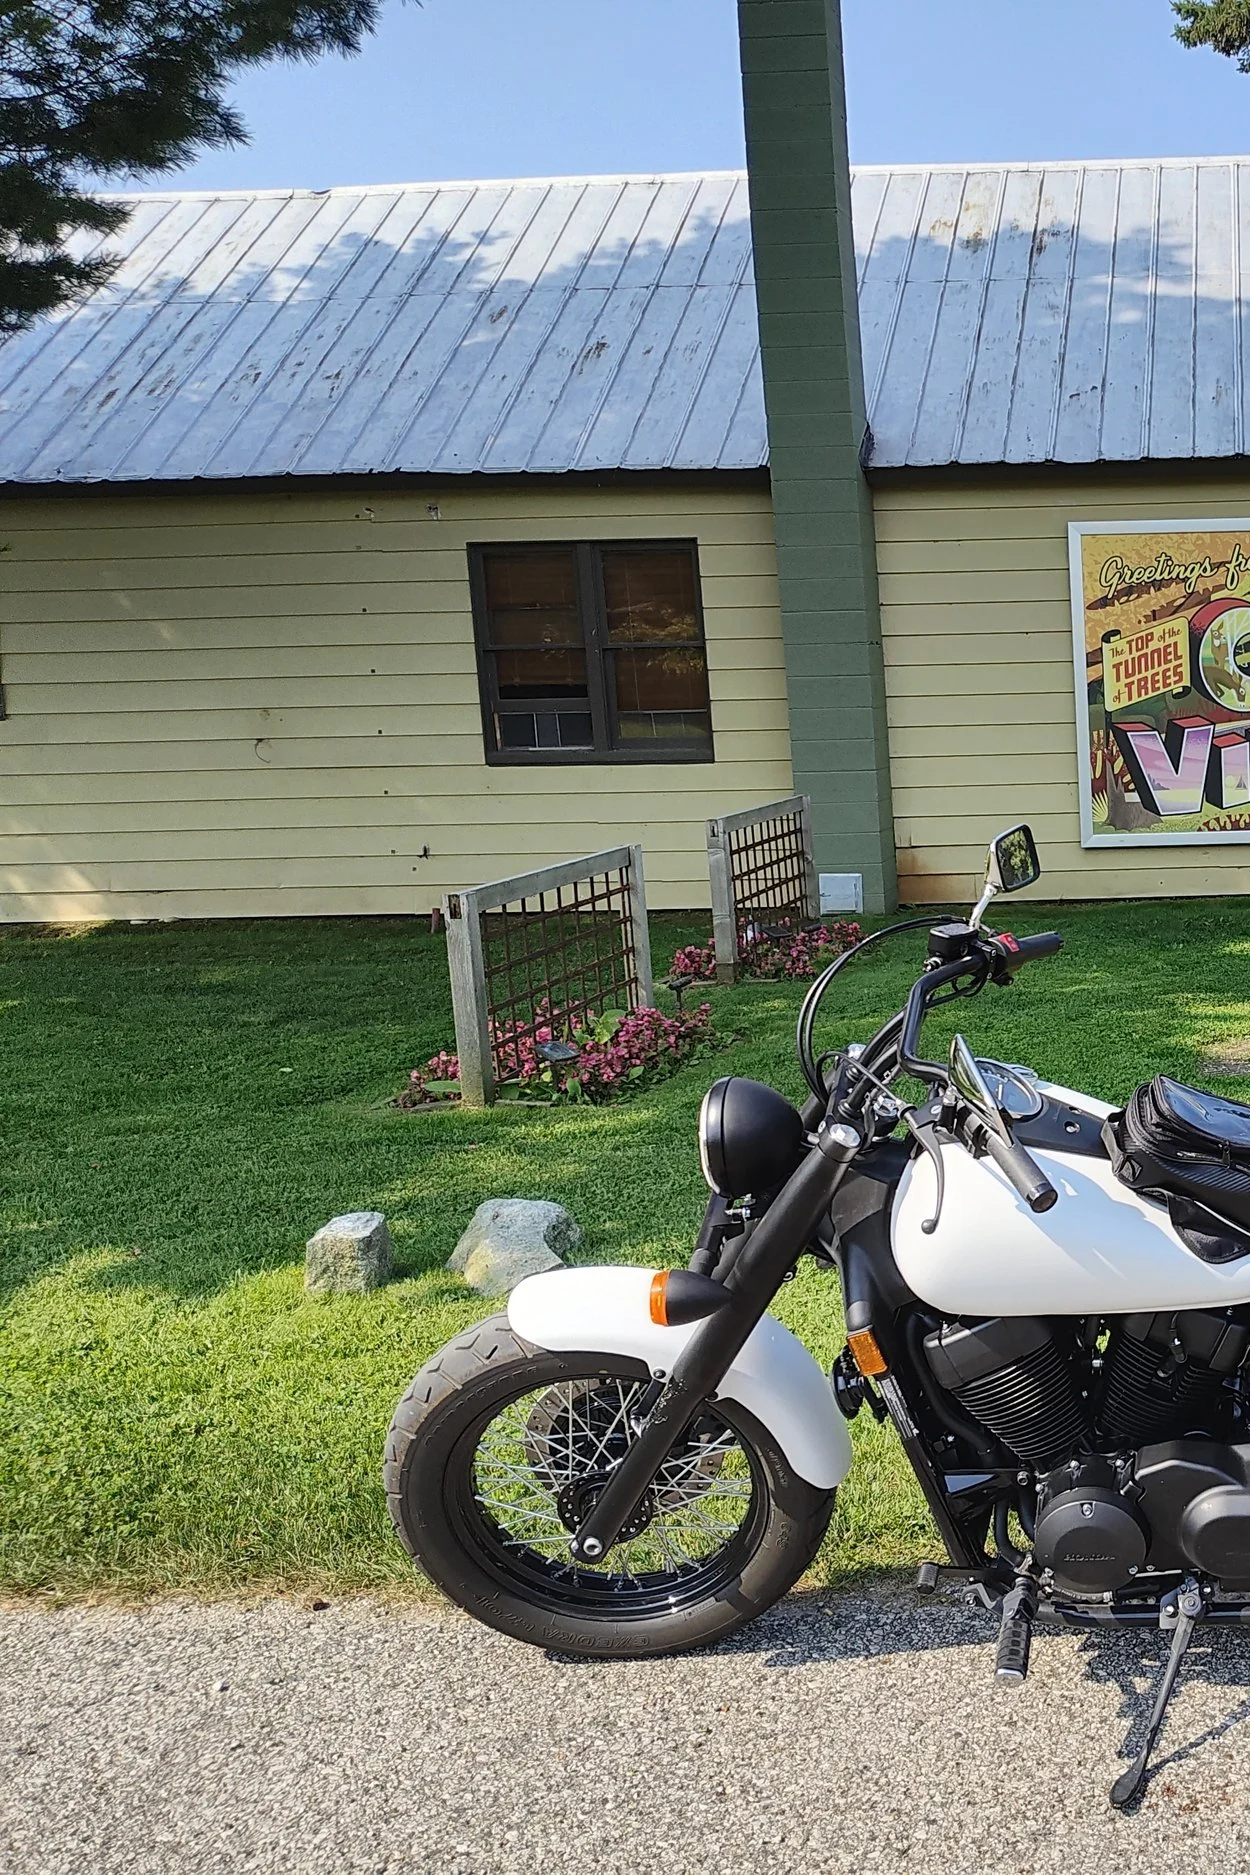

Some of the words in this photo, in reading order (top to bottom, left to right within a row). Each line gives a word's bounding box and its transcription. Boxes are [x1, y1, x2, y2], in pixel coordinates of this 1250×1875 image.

[1100, 552, 1217, 598] Greetings
[1109, 647, 1126, 658] The
[1126, 632, 1154, 655] TOP
[1157, 628, 1167, 643] of
[1166, 627, 1182, 639] the
[1112, 641, 1183, 683] TUNNEL
[1112, 689, 1126, 703] of
[1124, 663, 1183, 702] TREES
